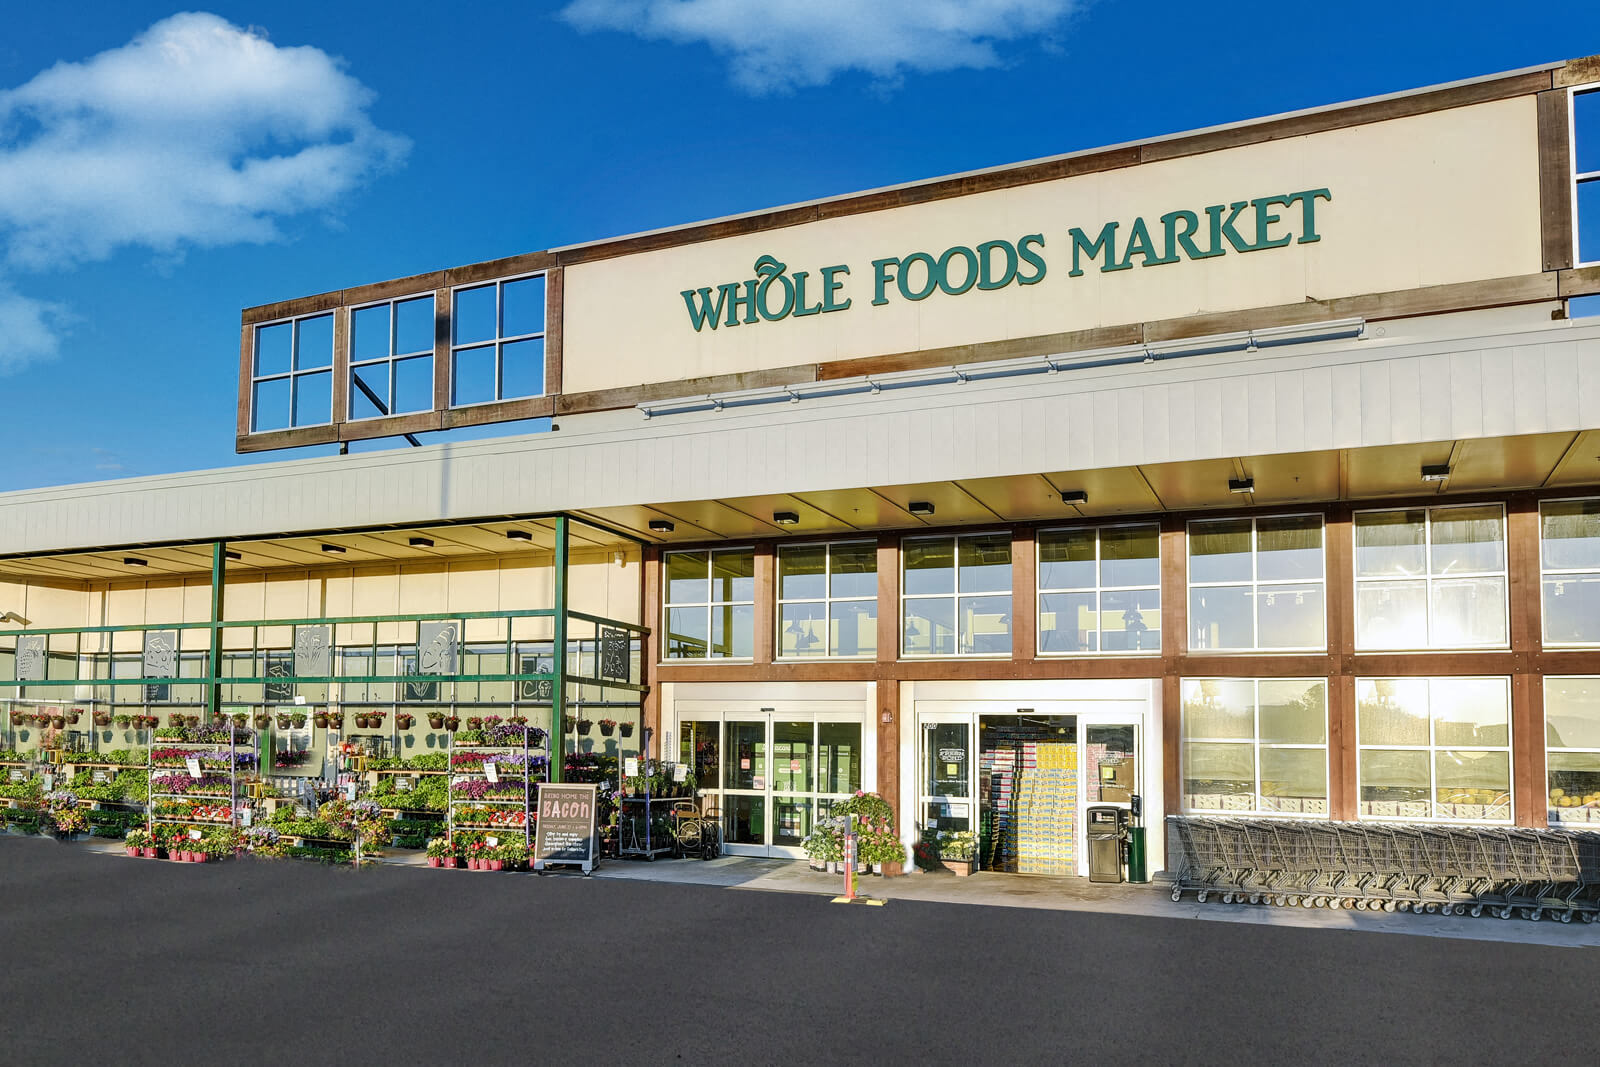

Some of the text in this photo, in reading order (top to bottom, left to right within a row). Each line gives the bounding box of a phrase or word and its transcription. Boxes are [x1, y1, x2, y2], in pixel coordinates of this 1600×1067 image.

[681, 188, 1332, 331] WHOLE FOODS MARKET
